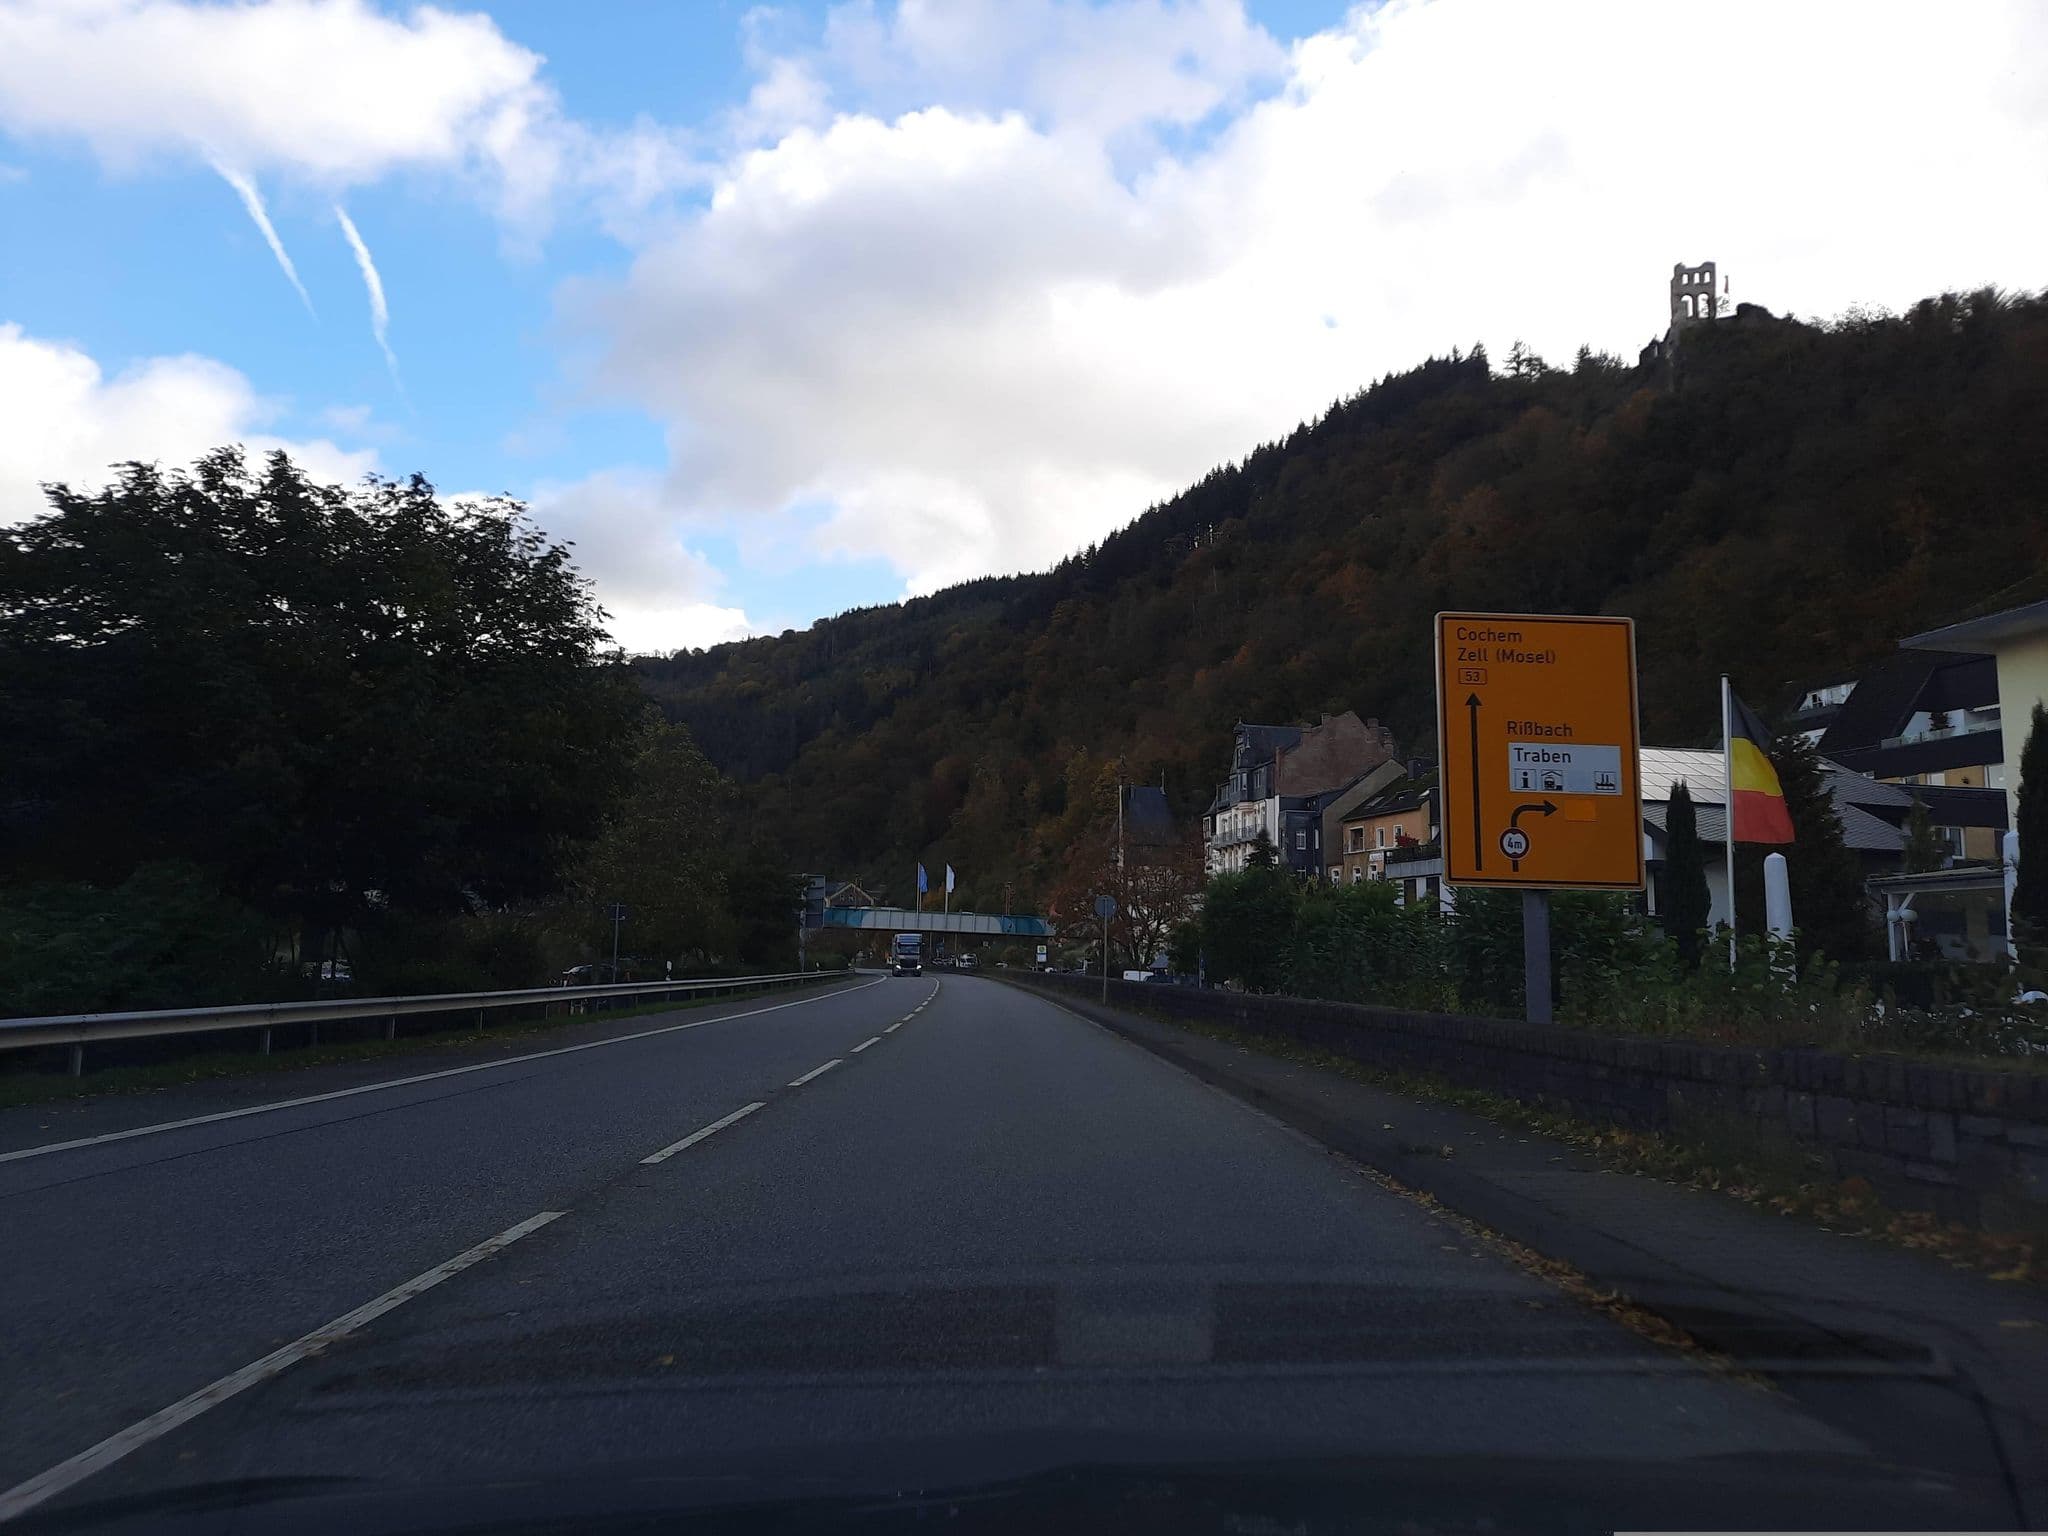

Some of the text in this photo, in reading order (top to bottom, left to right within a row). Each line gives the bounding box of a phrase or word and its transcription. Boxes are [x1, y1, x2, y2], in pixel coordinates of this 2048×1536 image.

[1456, 627, 1522, 643] Cochem
[1457, 648, 1556, 664] Zell (Mosel)
[1465, 671, 1480, 682] 53
[1507, 721, 1573, 737] Rißbach
[1513, 748, 1571, 763] Traben
[1507, 837, 1523, 850] 4m
